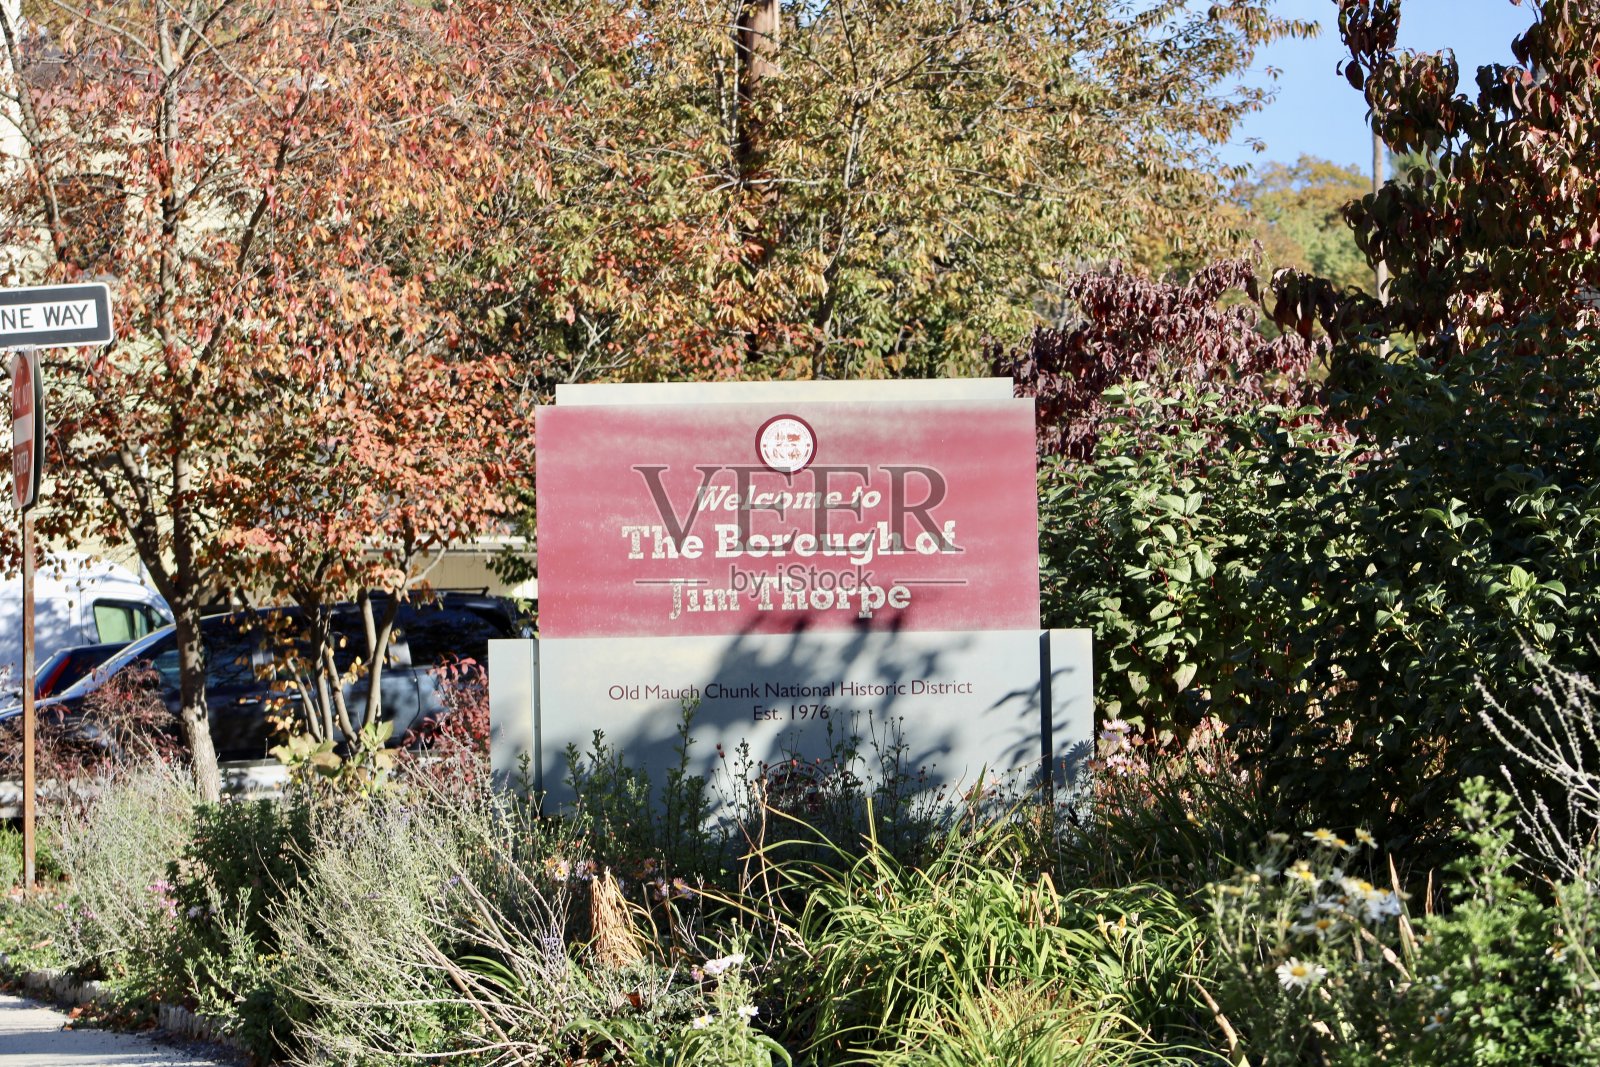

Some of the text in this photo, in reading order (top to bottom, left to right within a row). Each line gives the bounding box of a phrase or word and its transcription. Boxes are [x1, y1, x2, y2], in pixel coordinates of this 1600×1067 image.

[0, 304, 88, 330] NE WAY
[16, 451, 29, 477] ENTER
[697, 485, 882, 512] Welcome to
[621, 520, 957, 565] The Borough of
[669, 576, 912, 620] Jim Thorpe
[608, 679, 973, 700] Old Mauch Chunk National Historic District
[753, 704, 830, 721] Est. 1976
